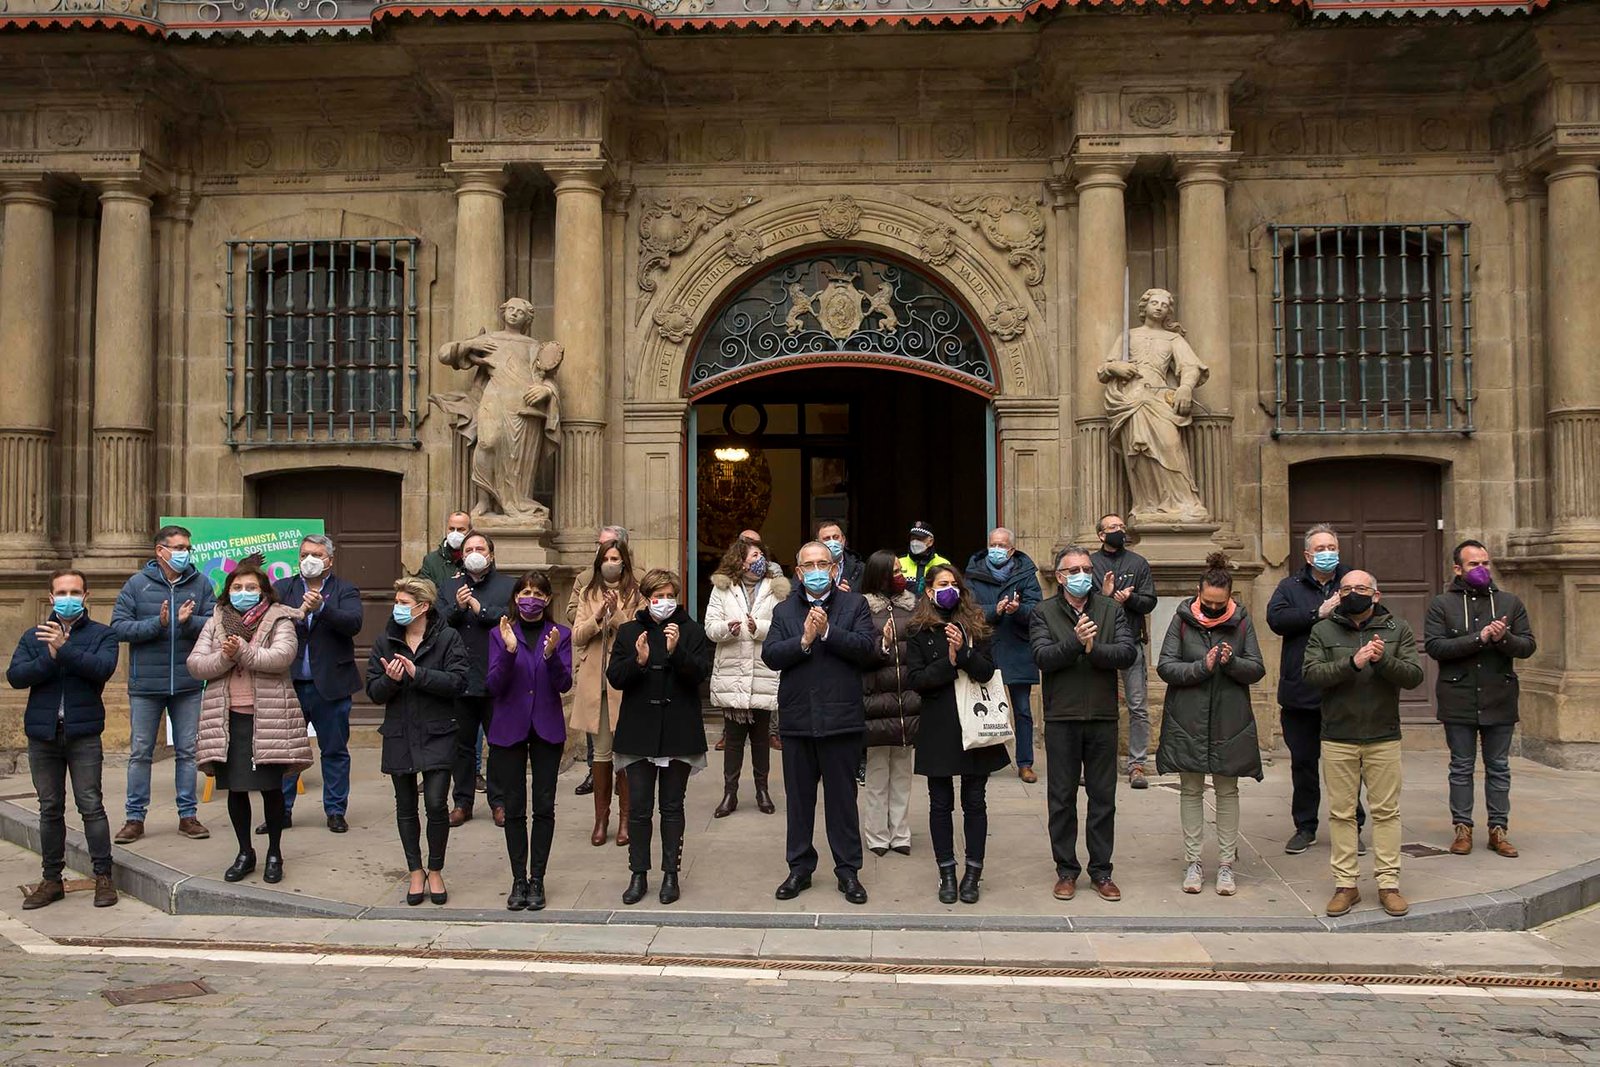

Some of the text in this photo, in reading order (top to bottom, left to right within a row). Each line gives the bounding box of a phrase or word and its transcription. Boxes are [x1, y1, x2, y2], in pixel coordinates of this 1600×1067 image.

[658, 222, 1025, 388] PATET OMNIBUS JANVA COR VALDE MAGIS
[192, 529, 302, 553] MUNDO FEMINISTA PARA
[244, 540, 299, 555] SOSTENIBLE
